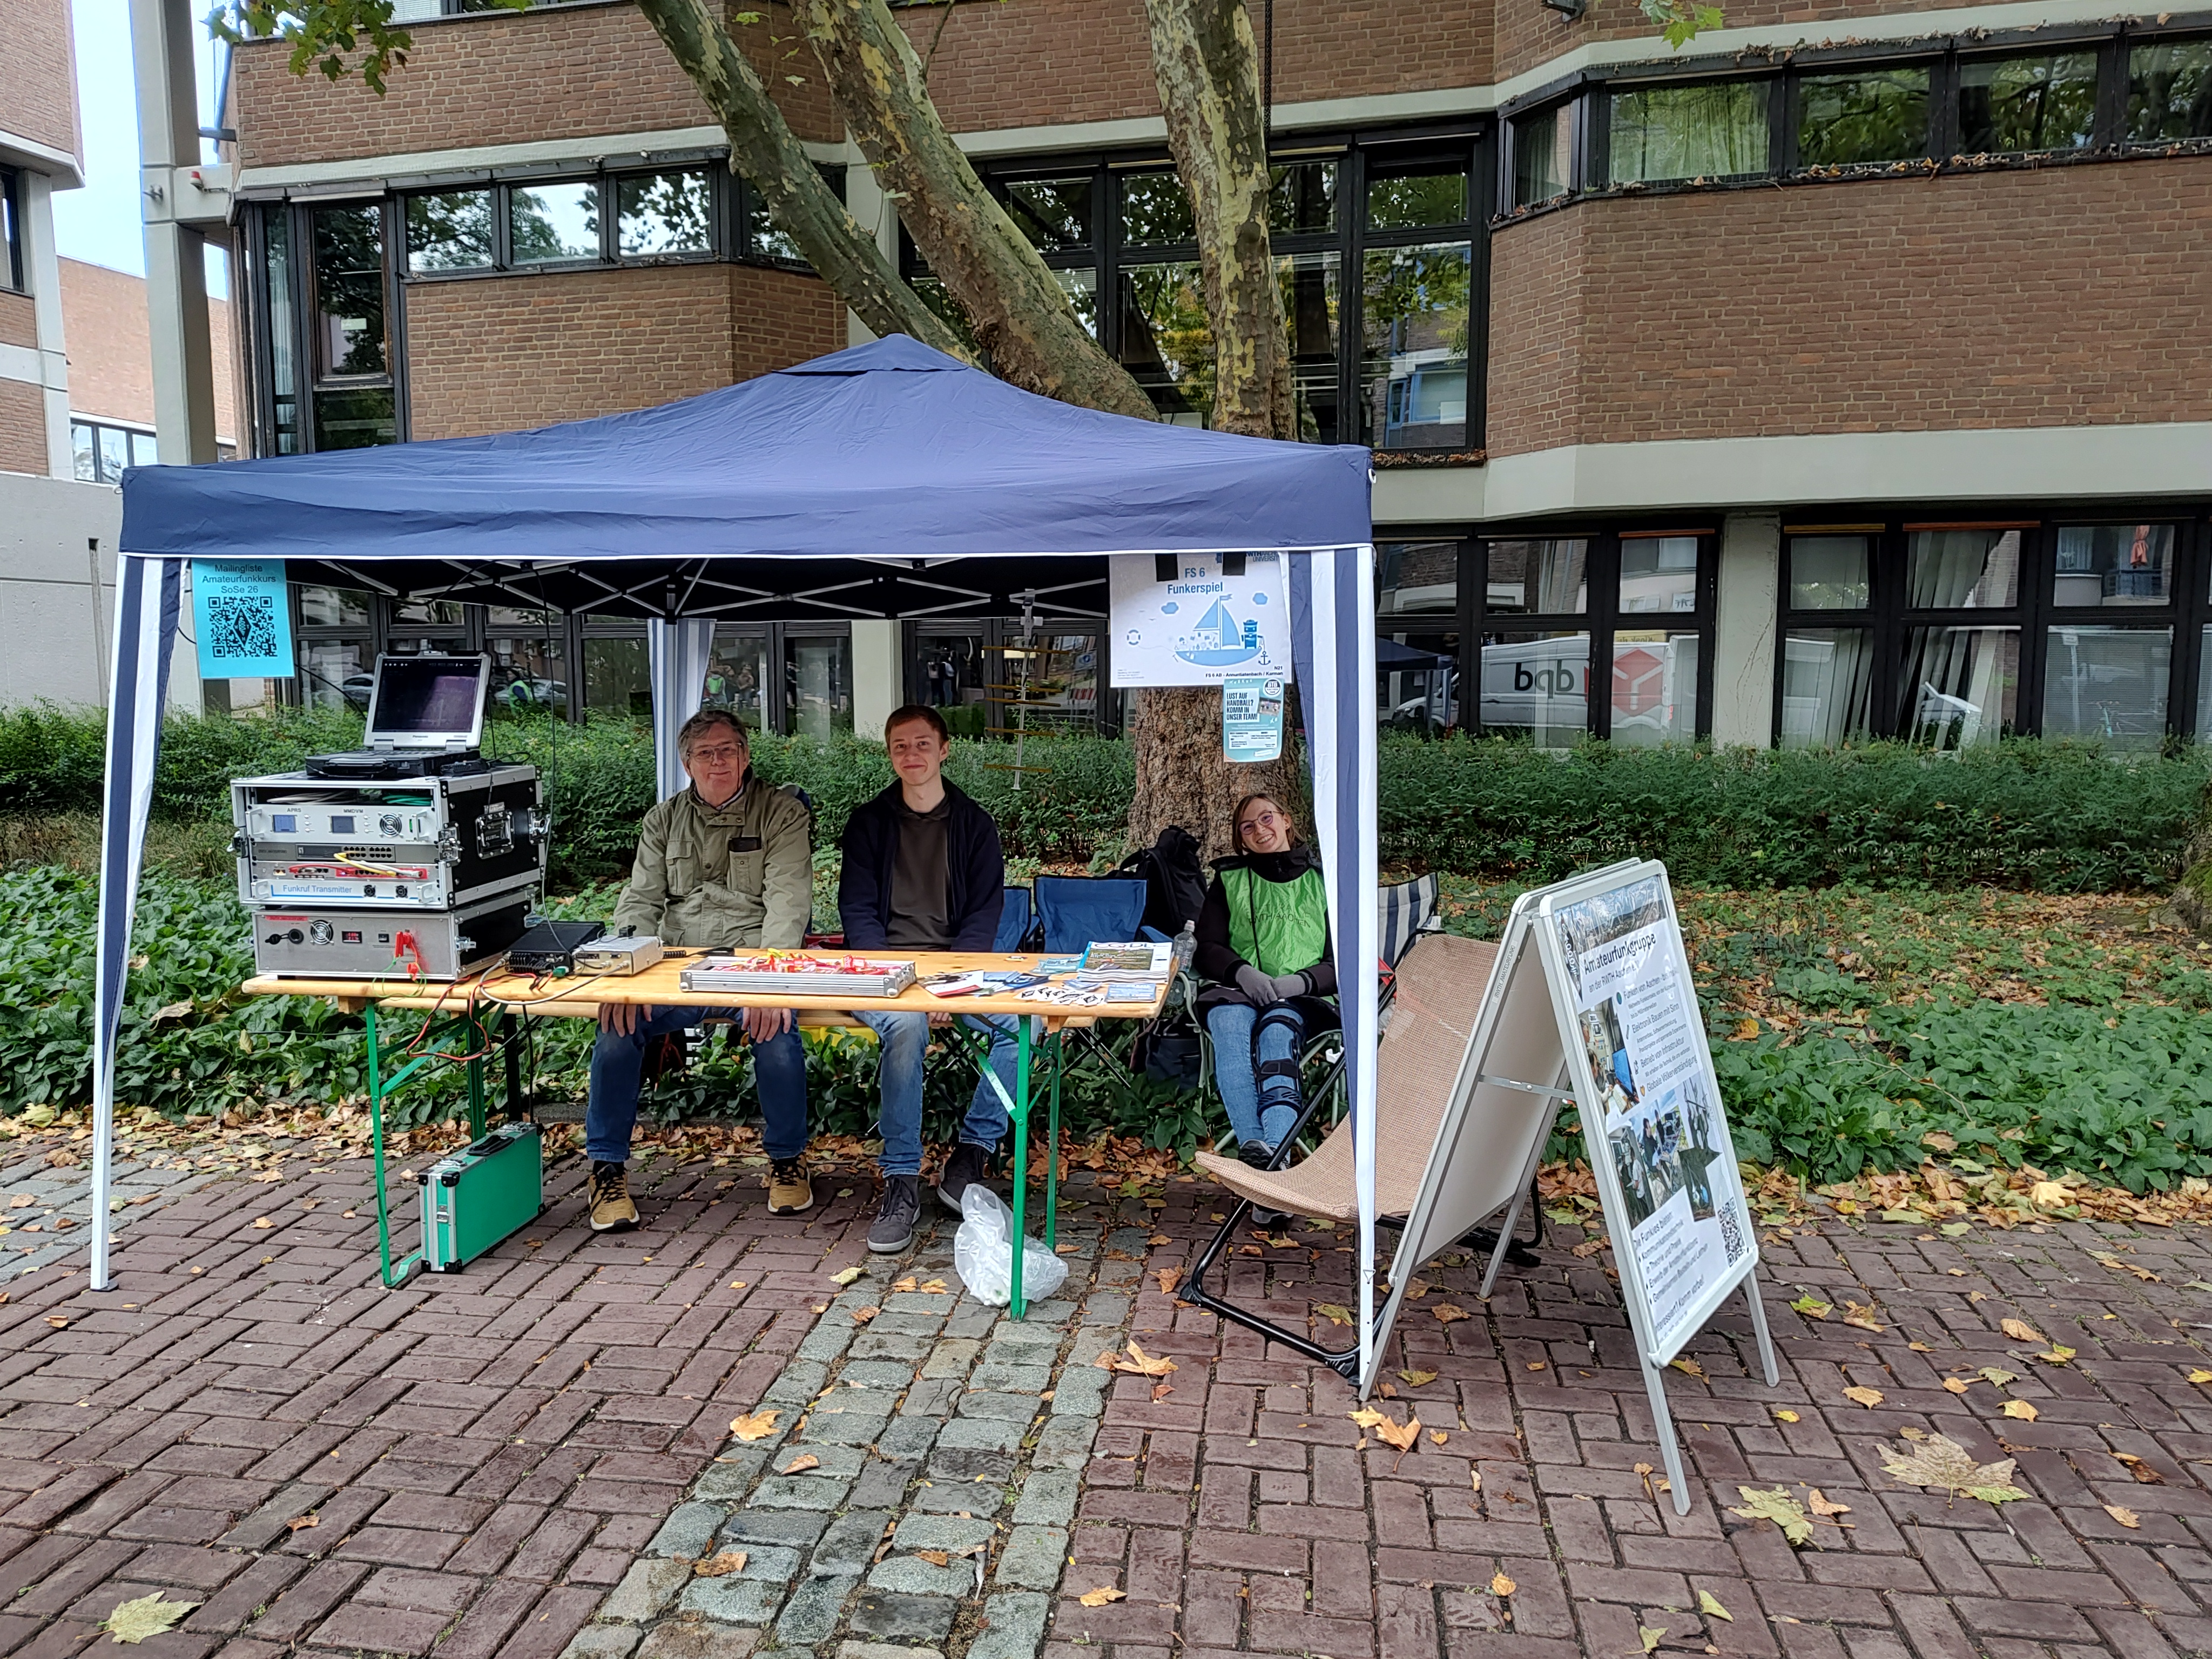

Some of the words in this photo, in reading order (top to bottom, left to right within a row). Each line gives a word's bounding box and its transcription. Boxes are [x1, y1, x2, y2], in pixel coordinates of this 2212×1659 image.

[215, 564, 262, 573] Mailingliste
[1185, 568, 1196, 578] FS
[1199, 567, 1205, 577] 6
[203, 575, 276, 583] Amateurfunkkurs
[1167, 582, 1223, 595] Funkerspiel
[283, 885, 310, 893] Funkruf
[313, 885, 352, 893] Transmitter
[1584, 933, 1656, 975] Amateurfunkgruppe
[1589, 984, 1595, 993] an
[1601, 973, 1615, 985] RWTH
[1623, 987, 1637, 1000] Funken
[1645, 977, 1661, 989] Aachen
[1631, 1016, 1652, 1034] Elektronik
[1650, 1011, 1664, 1023] Bauen
[1669, 1003, 1680, 1013] Sinn
[1640, 1053, 1655, 1068] Betrieb
[1654, 1050, 1662, 1059] von
[1661, 1036, 1684, 1055] Infrastruktur
[1647, 1077, 1662, 1092] Globale
[1661, 1054, 1698, 1082] Völkerverständigung
[1640, 1223, 1660, 1243] Funkies
[1654, 1301, 1679, 1336] nteressiert?
